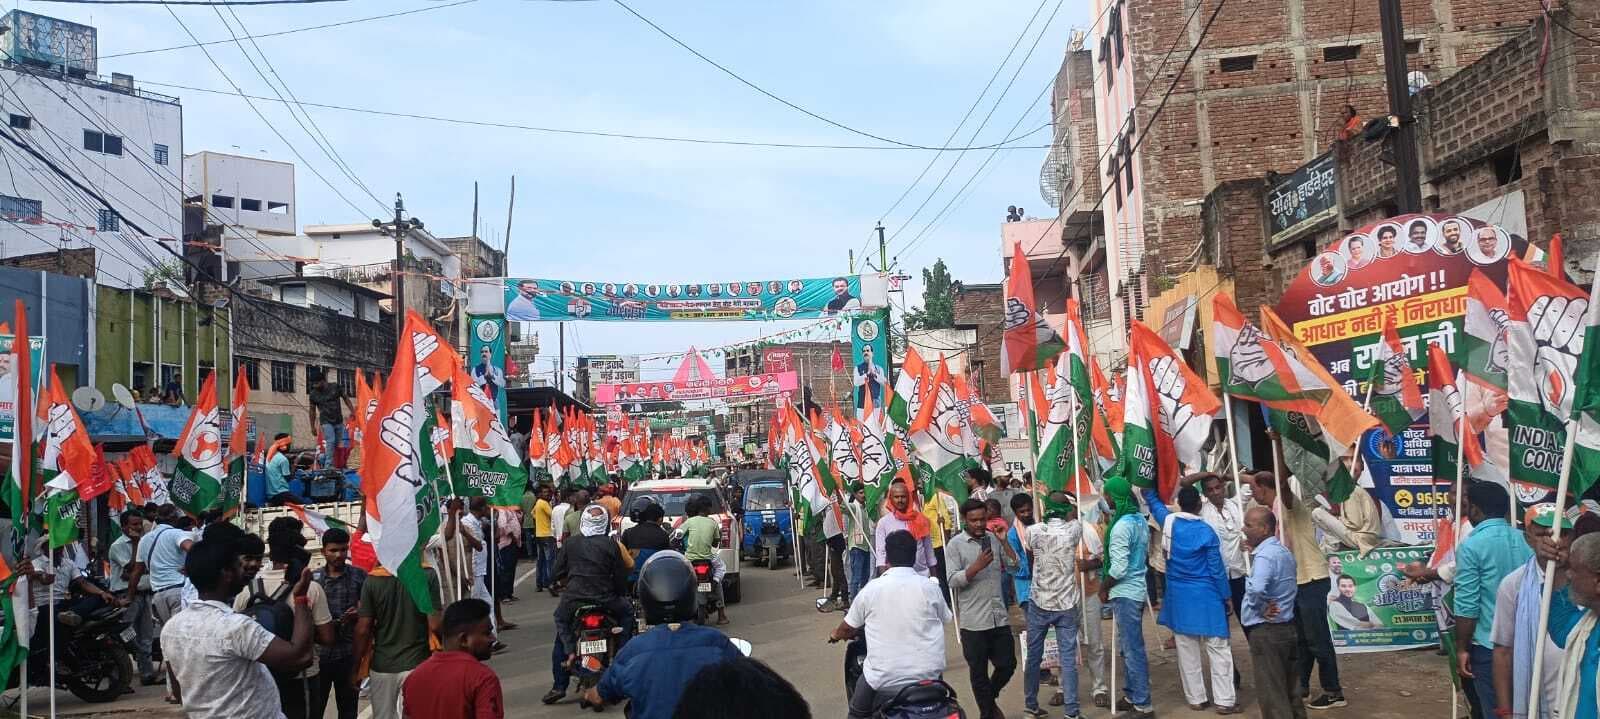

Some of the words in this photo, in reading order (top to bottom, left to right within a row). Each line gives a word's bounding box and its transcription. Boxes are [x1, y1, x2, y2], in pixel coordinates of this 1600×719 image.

[1308, 293, 1335, 316] वोट
[1338, 287, 1368, 310] चोर
[1372, 273, 1426, 302] आयोग
[1301, 319, 1347, 344] आधार
[1330, 359, 1350, 374] अब
